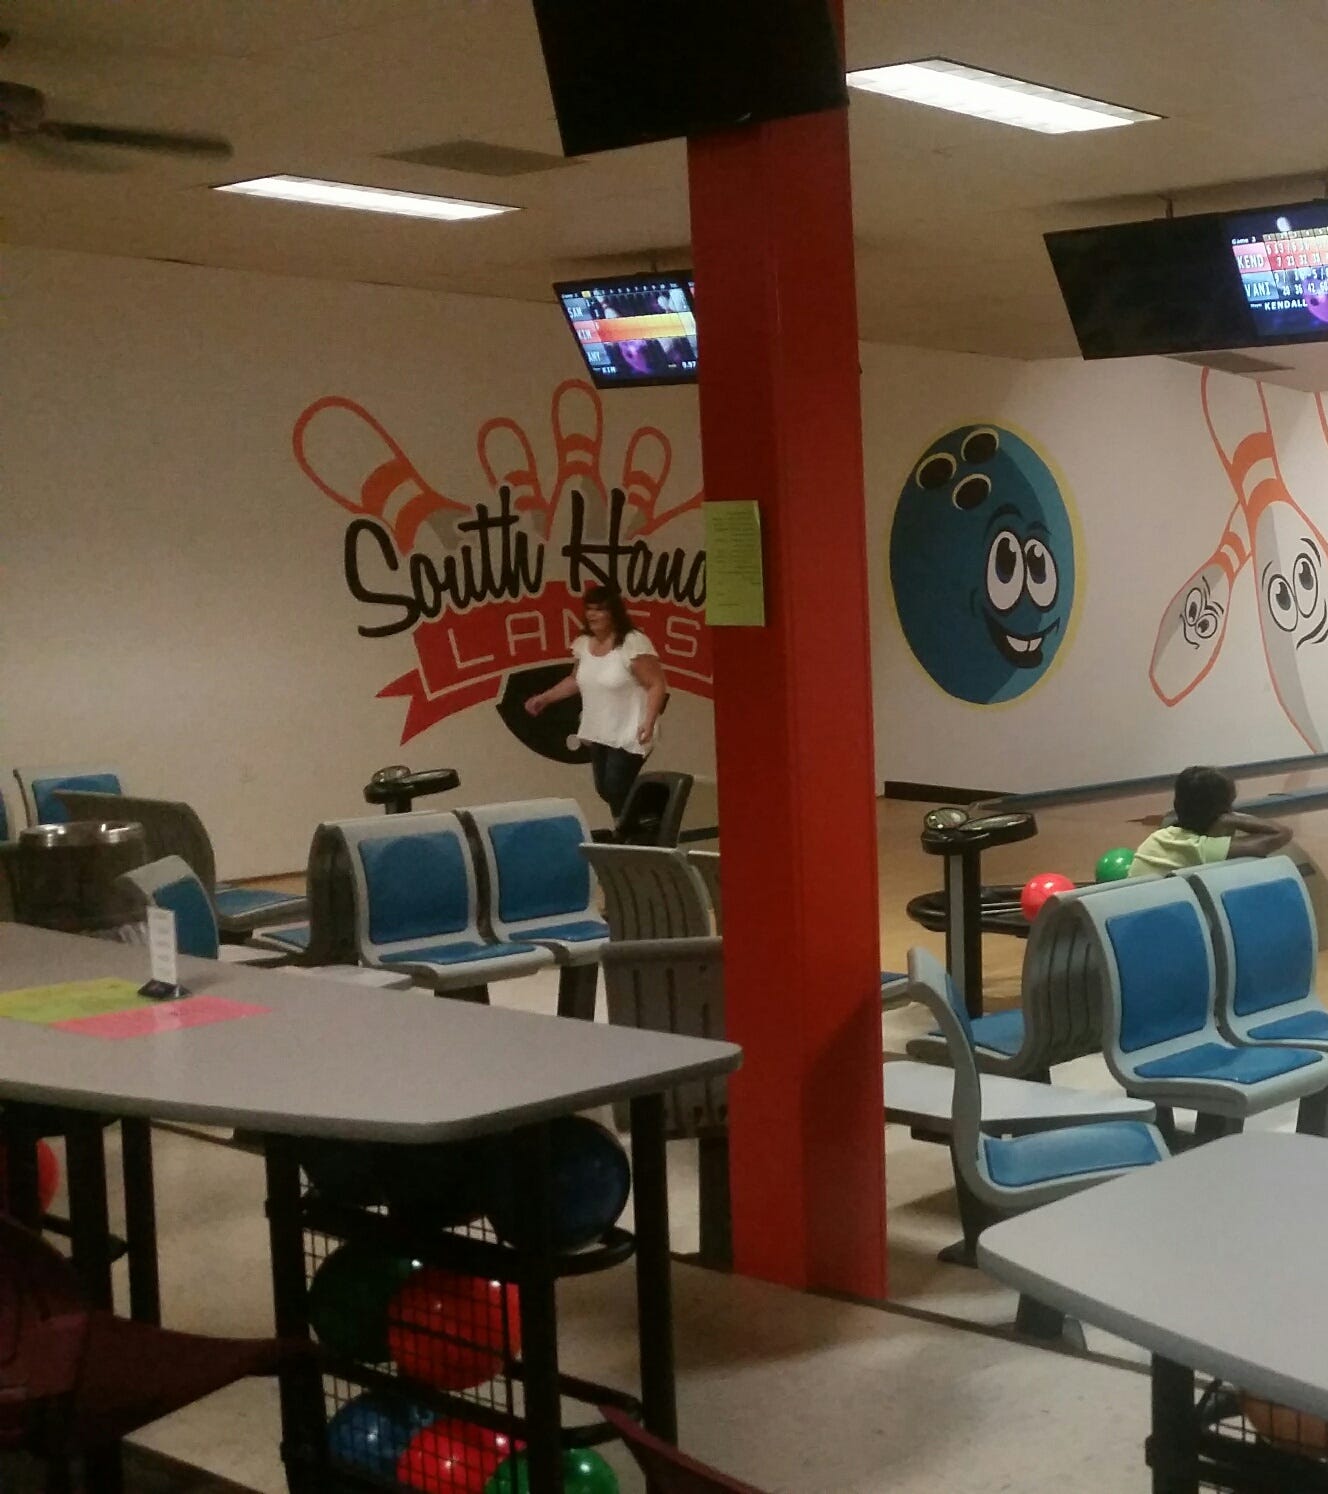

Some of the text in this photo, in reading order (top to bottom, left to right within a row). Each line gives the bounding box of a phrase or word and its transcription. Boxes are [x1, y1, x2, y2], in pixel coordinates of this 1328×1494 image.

[1237, 253, 1264, 269] KEND
[1264, 298, 1308, 311] KENDALL
[344, 485, 544, 638] South
[447, 608, 701, 669] LANS
